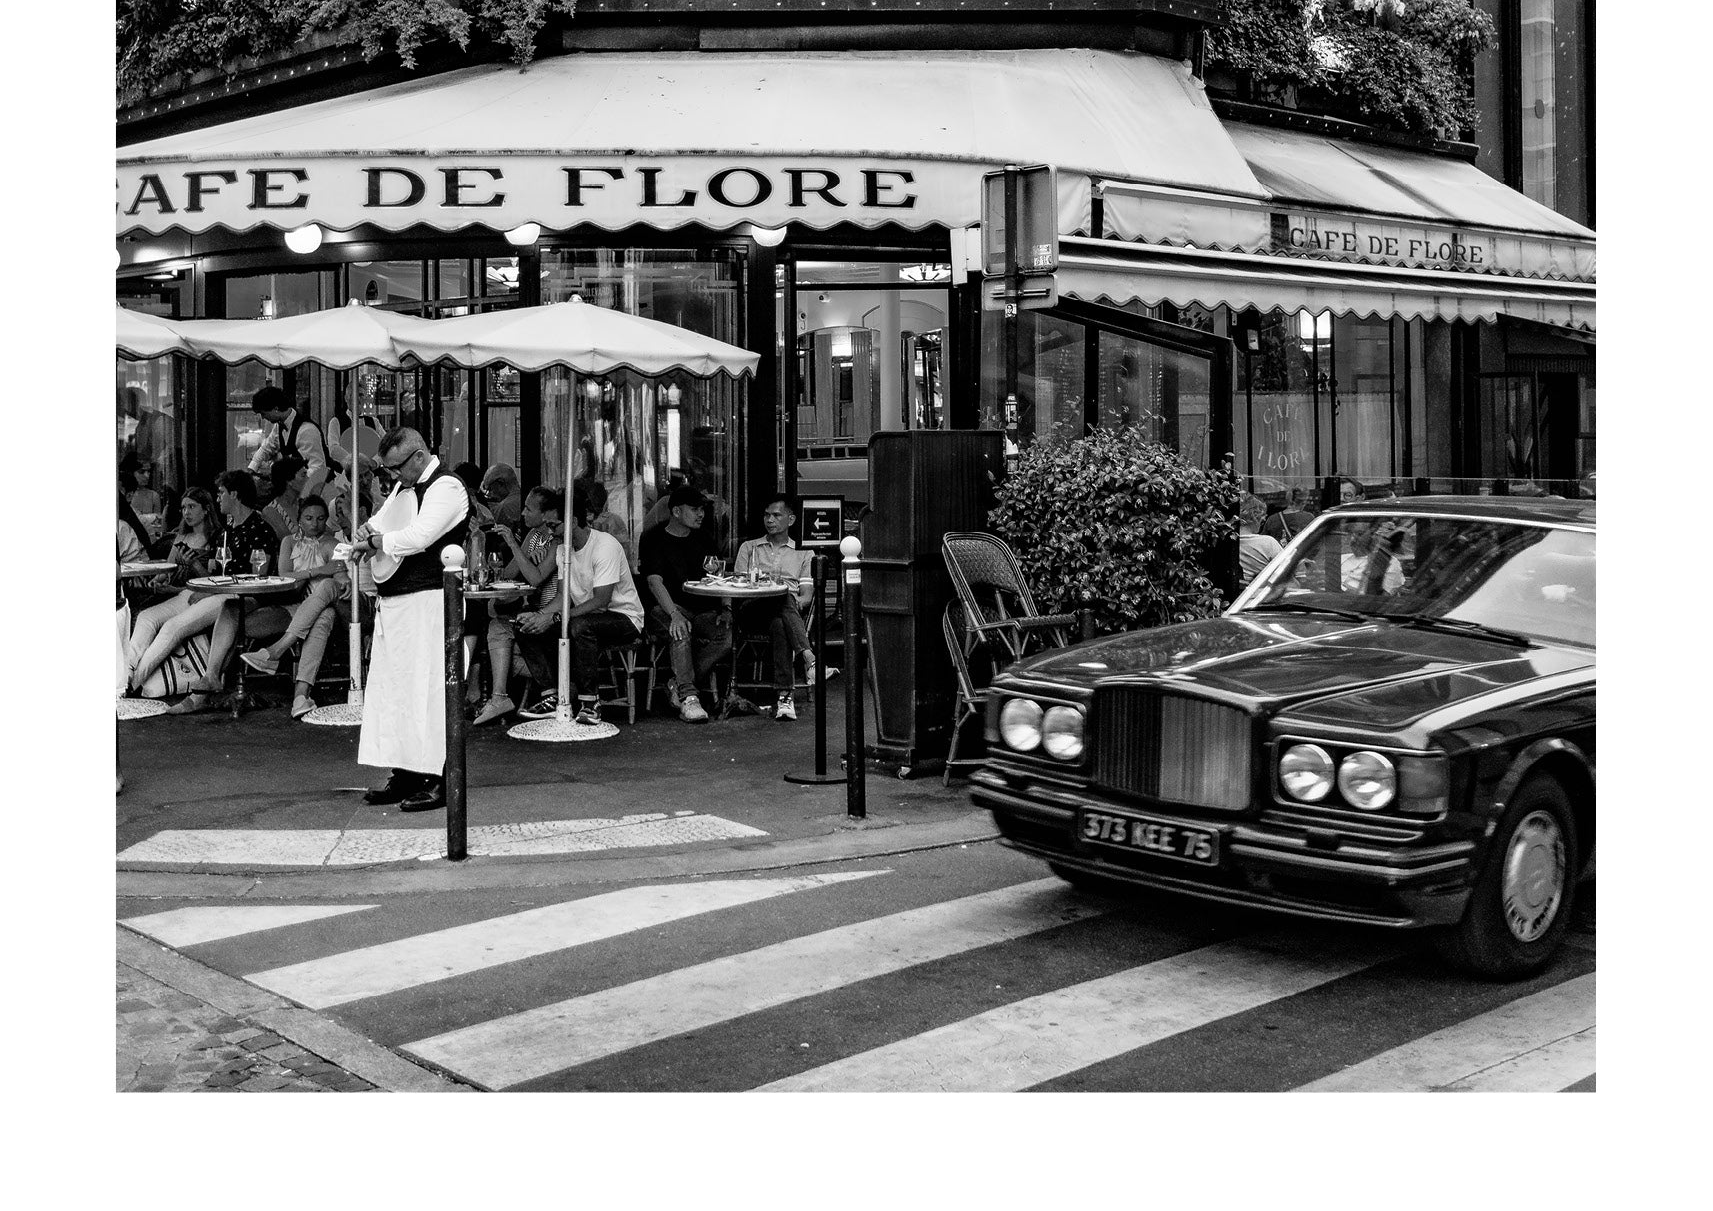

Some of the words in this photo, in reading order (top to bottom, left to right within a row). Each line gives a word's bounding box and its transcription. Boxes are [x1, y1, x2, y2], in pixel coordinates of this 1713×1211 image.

[117, 167, 311, 216] AFE
[362, 166, 505, 208] DE
[560, 166, 917, 208] FLORE
[1290, 228, 1356, 252] CAFE
[1367, 235, 1399, 256] DE
[1408, 239, 1483, 264] FLORE
[1083, 813, 1127, 842] 373
[1181, 831, 1212, 859] 75
